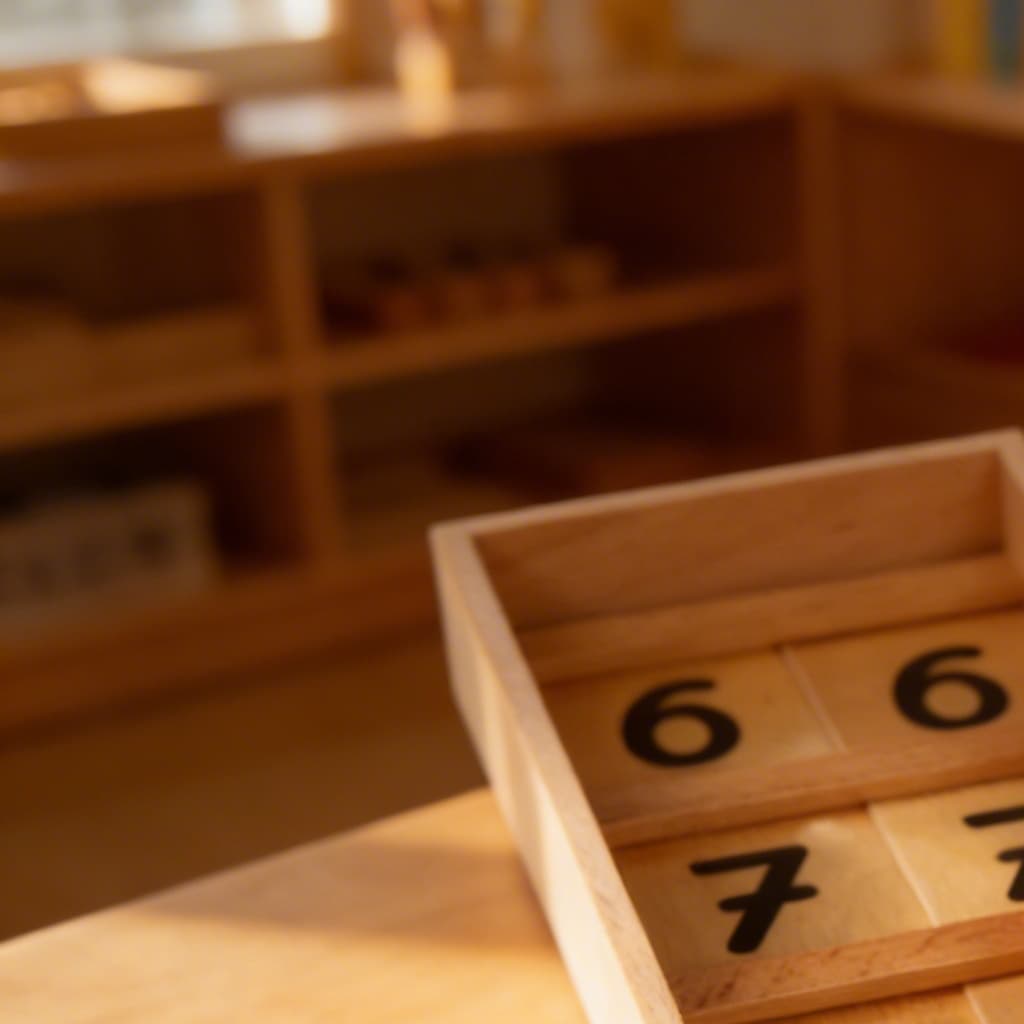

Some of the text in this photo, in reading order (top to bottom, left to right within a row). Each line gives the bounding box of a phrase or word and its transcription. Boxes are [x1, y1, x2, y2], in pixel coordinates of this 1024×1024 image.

[621, 645, 1009, 768] 6 6
[690, 845, 818, 954] 7
